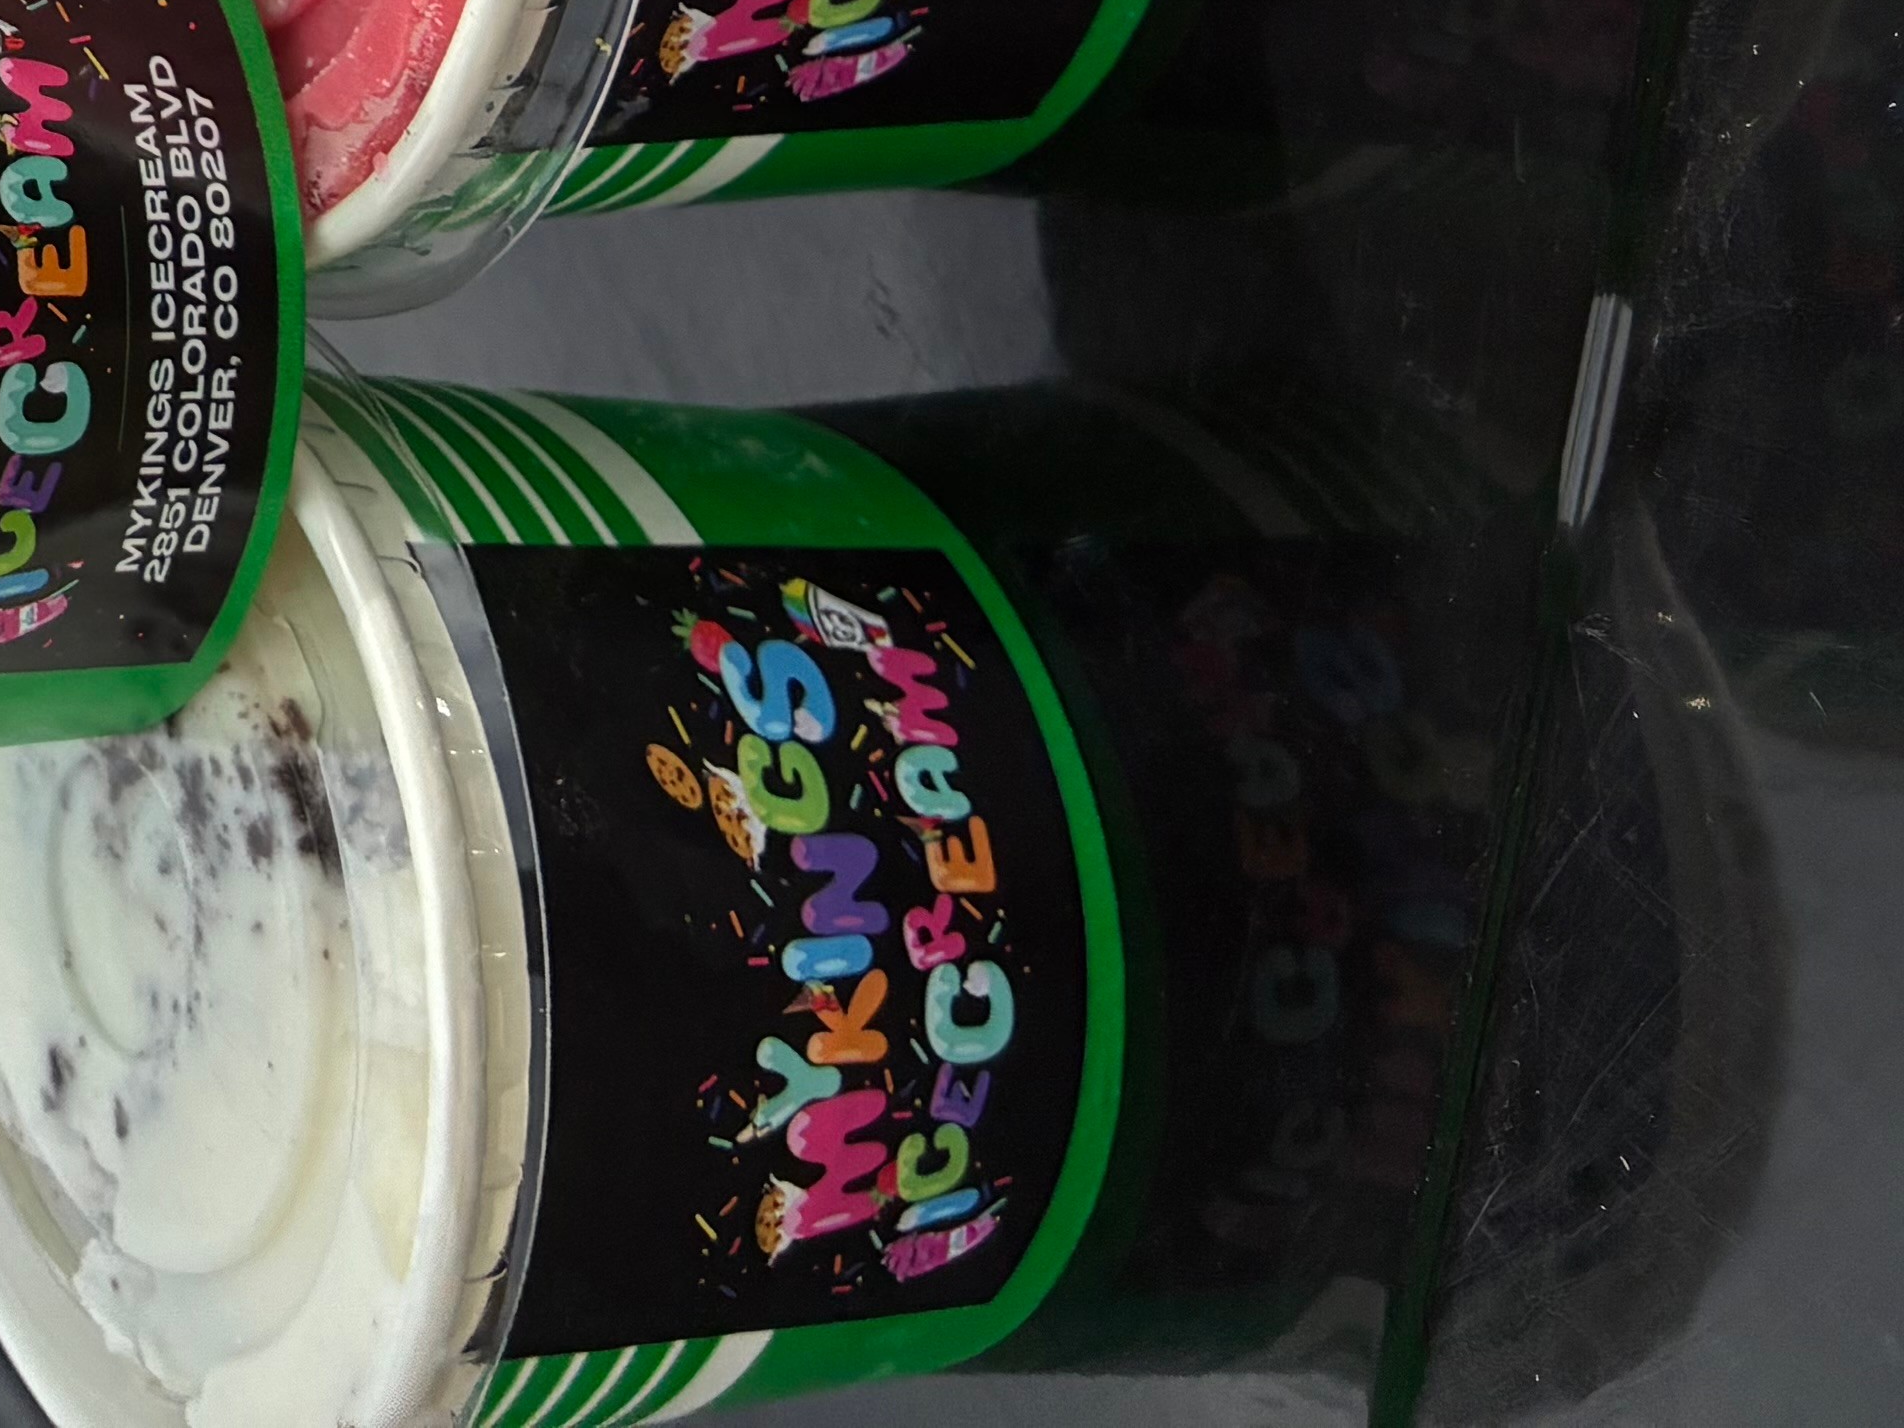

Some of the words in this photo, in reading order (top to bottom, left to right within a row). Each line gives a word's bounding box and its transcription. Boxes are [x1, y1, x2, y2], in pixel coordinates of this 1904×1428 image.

[148, 54, 197, 179] BLVD
[185, 86, 236, 250] 80207
[123, 83, 176, 342] ICECREAM
[211, 265, 239, 340] CO
[172, 194, 207, 473] COLORADO
[113, 358, 177, 574] MYKINGS
[142, 486, 191, 583] 2851
[183, 354, 242, 553] DENVER,
